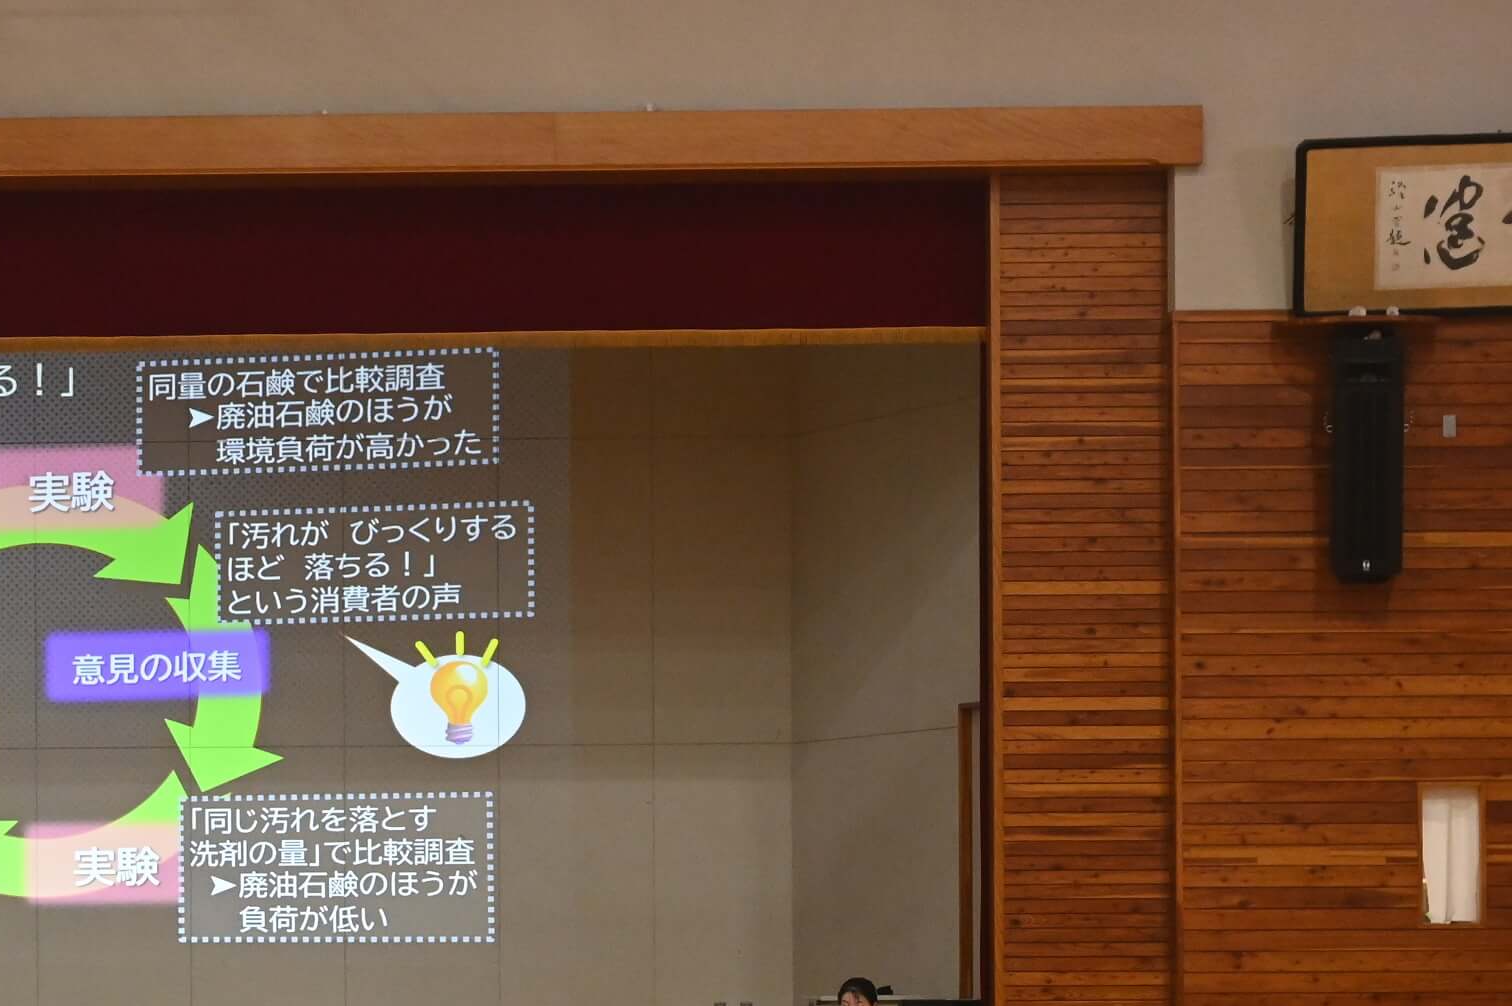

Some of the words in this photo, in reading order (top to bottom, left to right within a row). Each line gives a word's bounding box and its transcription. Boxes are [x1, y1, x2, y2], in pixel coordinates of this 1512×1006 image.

[148, 363, 446, 402] 同量の石鹸で比較調査
[216, 394, 453, 431] 廃油石鹸のほうが
[216, 429, 483, 466] 環境負荷が高かった
[28, 472, 116, 516] 実験
[227, 554, 286, 582] ほど
[227, 582, 462, 615] という消費者の声
[71, 649, 243, 686] 意見の収集
[190, 804, 437, 835] 「同じ汚れを落とす
[73, 845, 161, 888] 実験
[189, 836, 476, 868] 洗剤の量」で比較調査
[238, 869, 478, 900] 廃油石鹸のほうが
[238, 904, 389, 934] 負荷が低い
